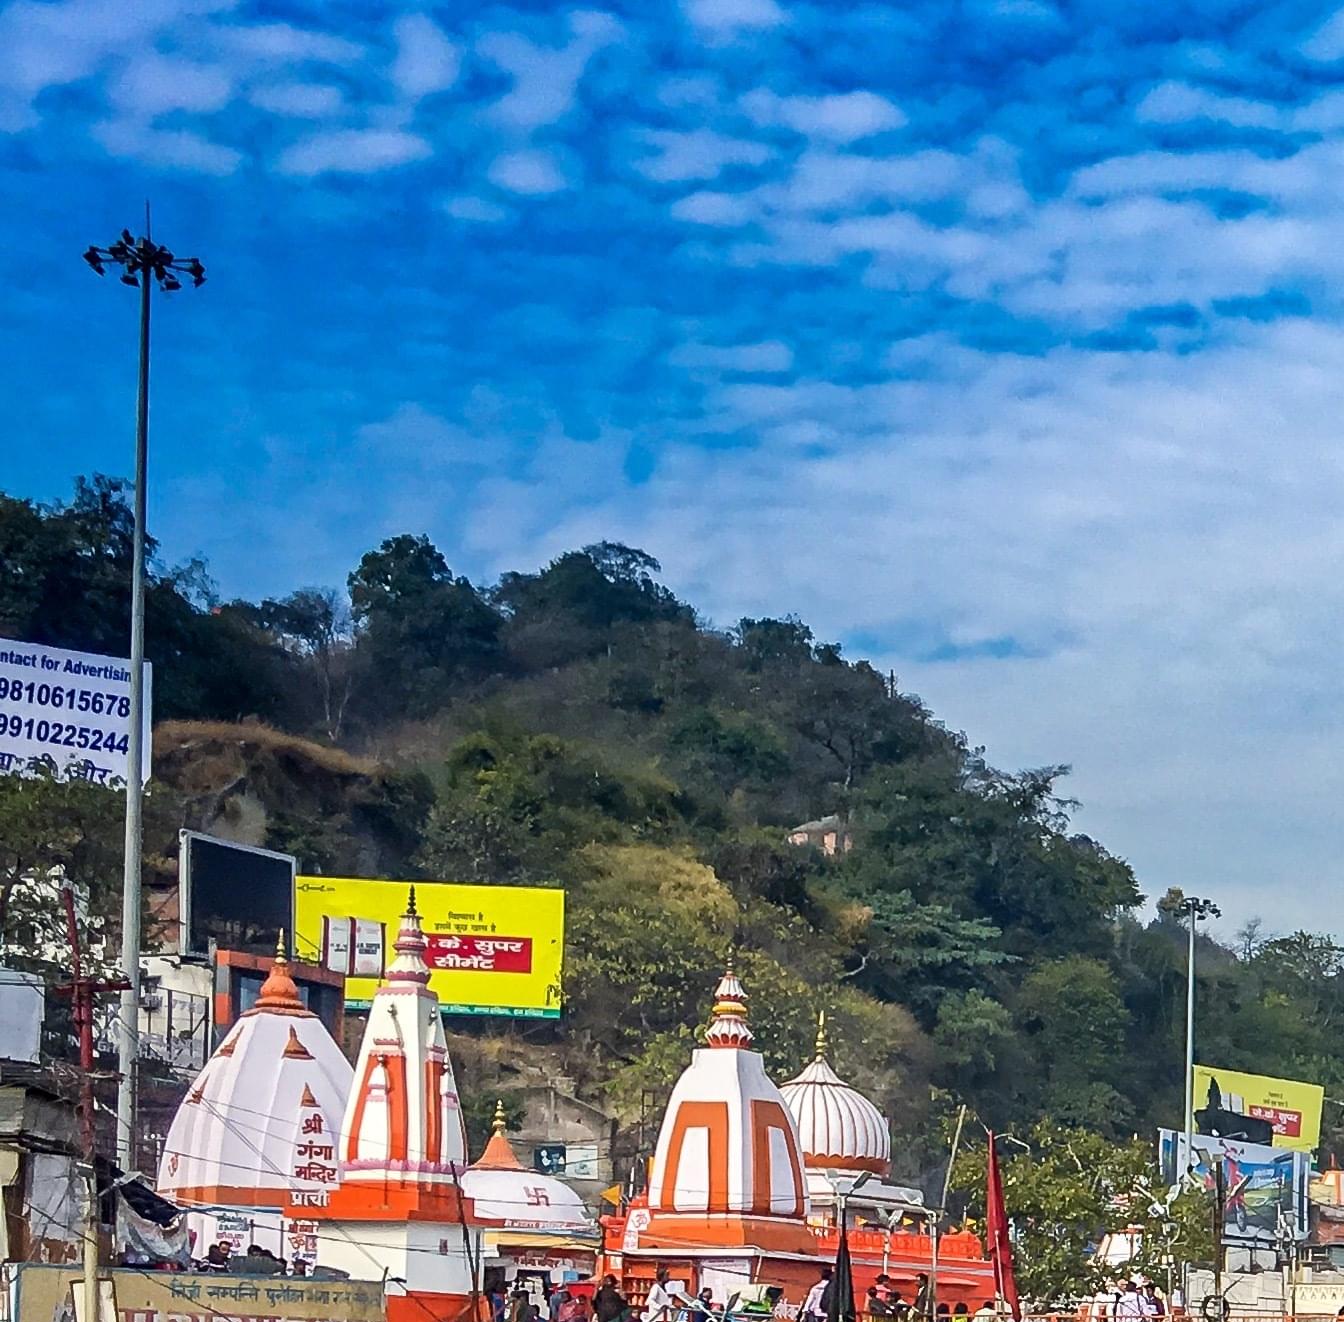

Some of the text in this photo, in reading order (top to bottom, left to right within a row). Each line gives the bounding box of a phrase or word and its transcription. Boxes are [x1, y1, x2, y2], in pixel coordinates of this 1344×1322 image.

[0, 650, 131, 682] ntact for Advertisin
[0, 677, 131, 718] 9810615678
[0, 713, 129, 755] 9910225244
[473, 938, 524, 955] सुपर
[434, 953, 495, 969] सीमेंट
[302, 1113, 323, 1134] श्री
[297, 1140, 333, 1160] गंगा
[294, 1162, 337, 1184] मन्दिर
